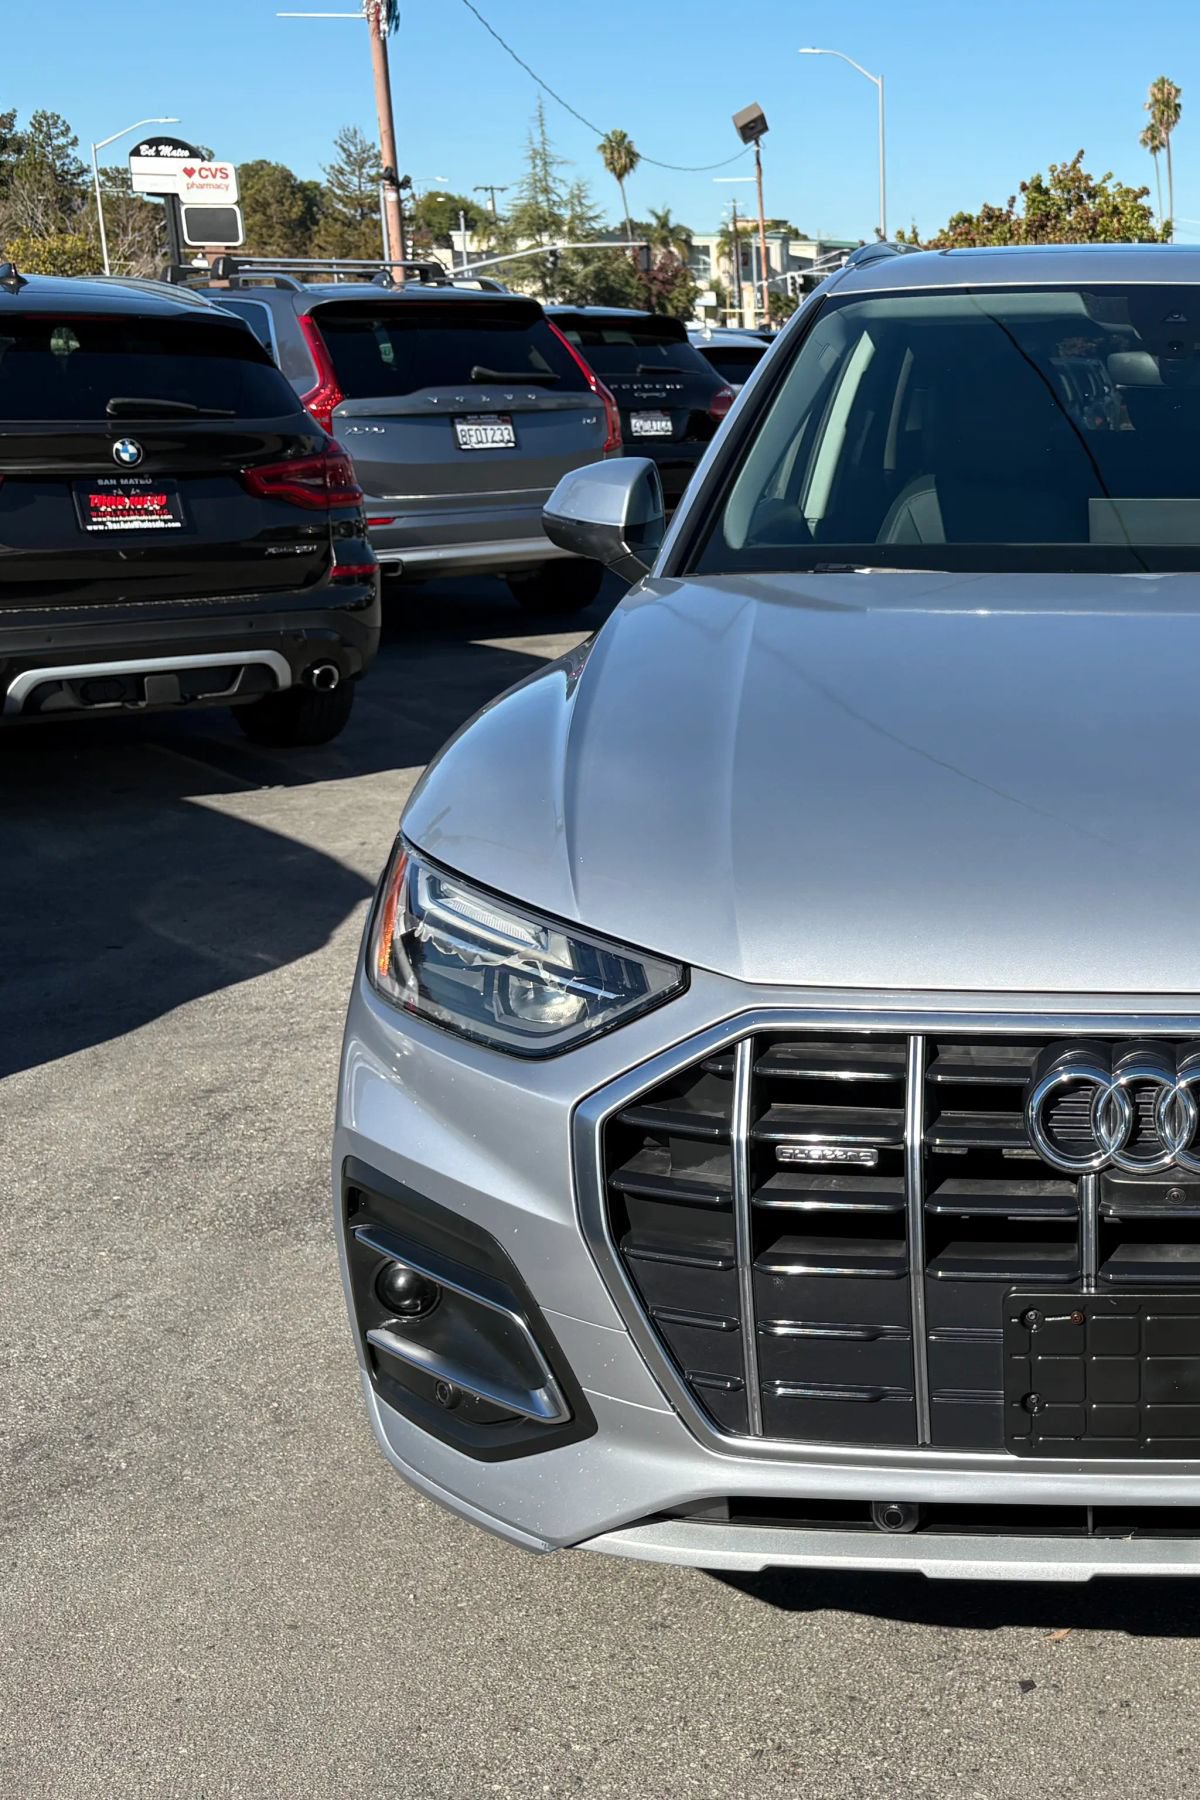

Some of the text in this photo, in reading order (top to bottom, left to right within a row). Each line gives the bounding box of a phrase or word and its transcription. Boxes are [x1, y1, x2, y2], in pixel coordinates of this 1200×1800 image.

[198, 166, 230, 180] CVS
[186, 181, 230, 191] pharmacy
[97, 478, 117, 486] SAN
